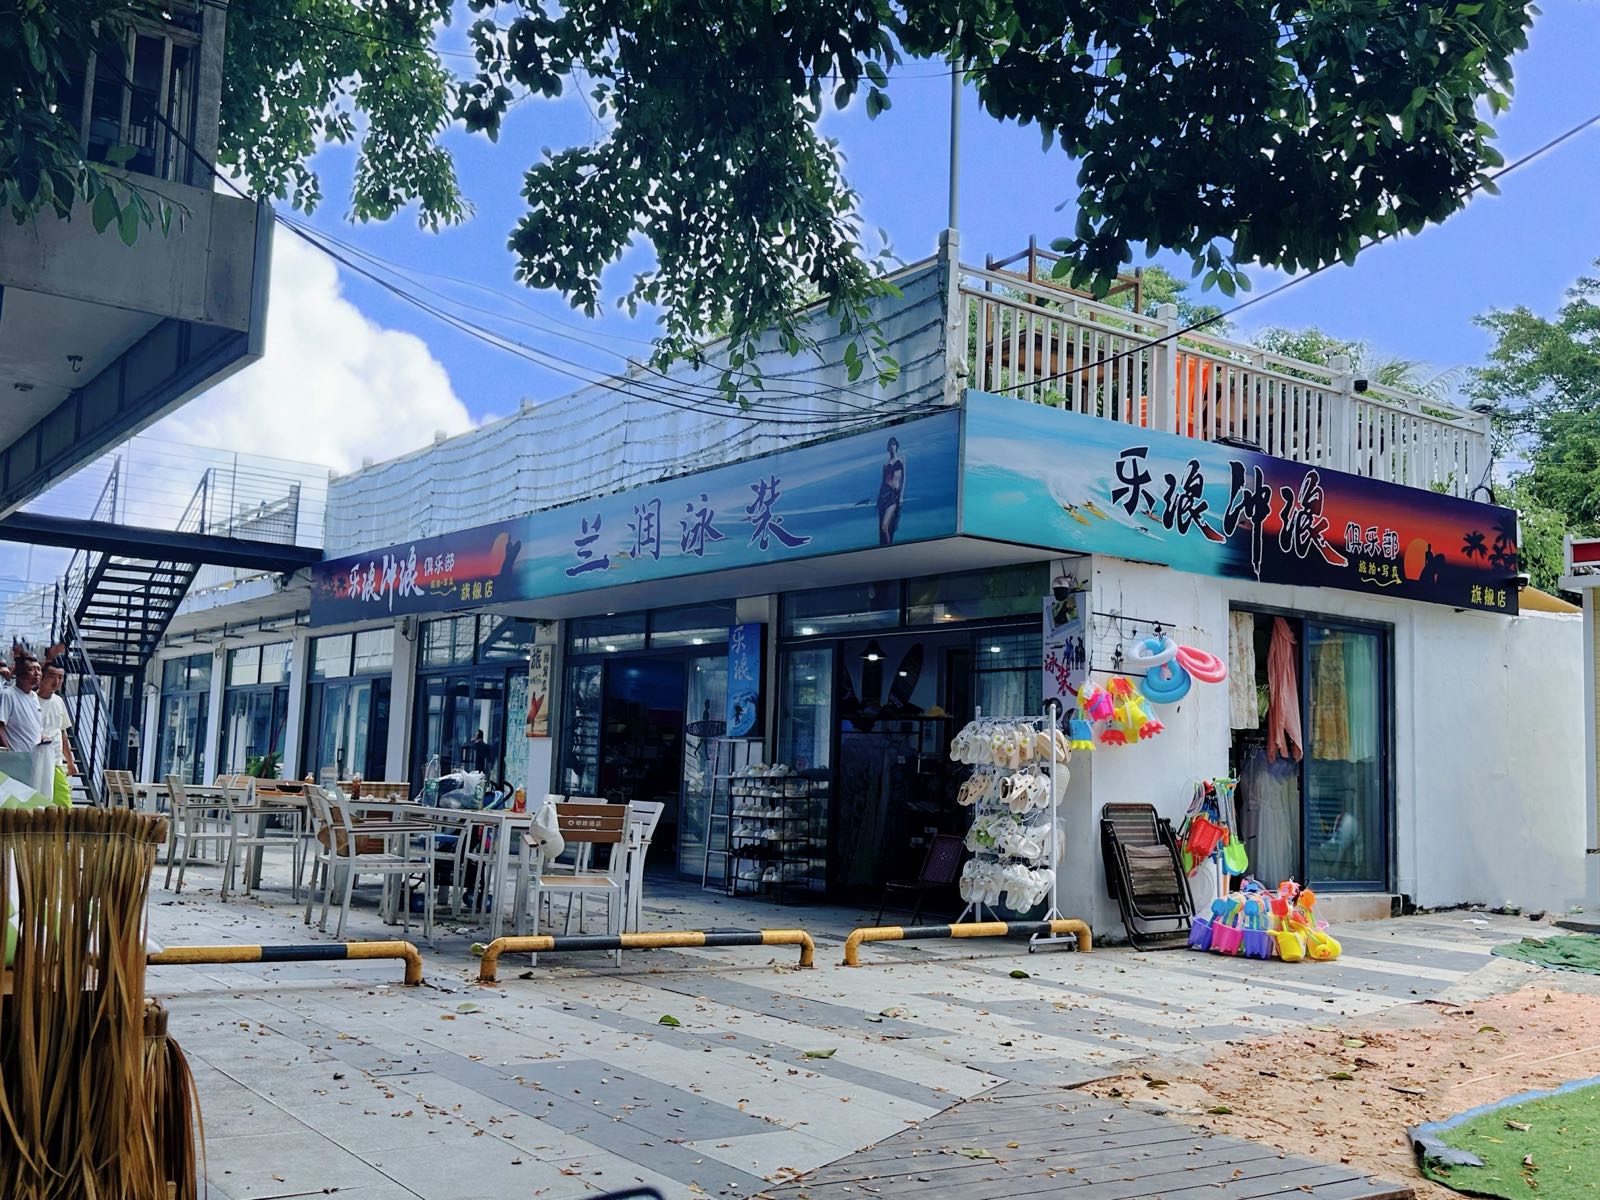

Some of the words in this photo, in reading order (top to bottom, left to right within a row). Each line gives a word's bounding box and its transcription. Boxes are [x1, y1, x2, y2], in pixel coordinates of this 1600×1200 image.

[565, 474, 812, 577] 兰润泳装
[1111, 446, 1348, 582] 乐浪冲浪
[1343, 521, 1400, 560] 俱乐部
[348, 545, 424, 612] 乐浪冲浪
[424, 552, 456, 577] 俱乐部
[460, 579, 494, 601] 旗舰店
[1470, 584, 1507, 609] 旗舰店
[731, 625, 753, 681] 乐浪
[1045, 651, 1079, 697] 泳装
